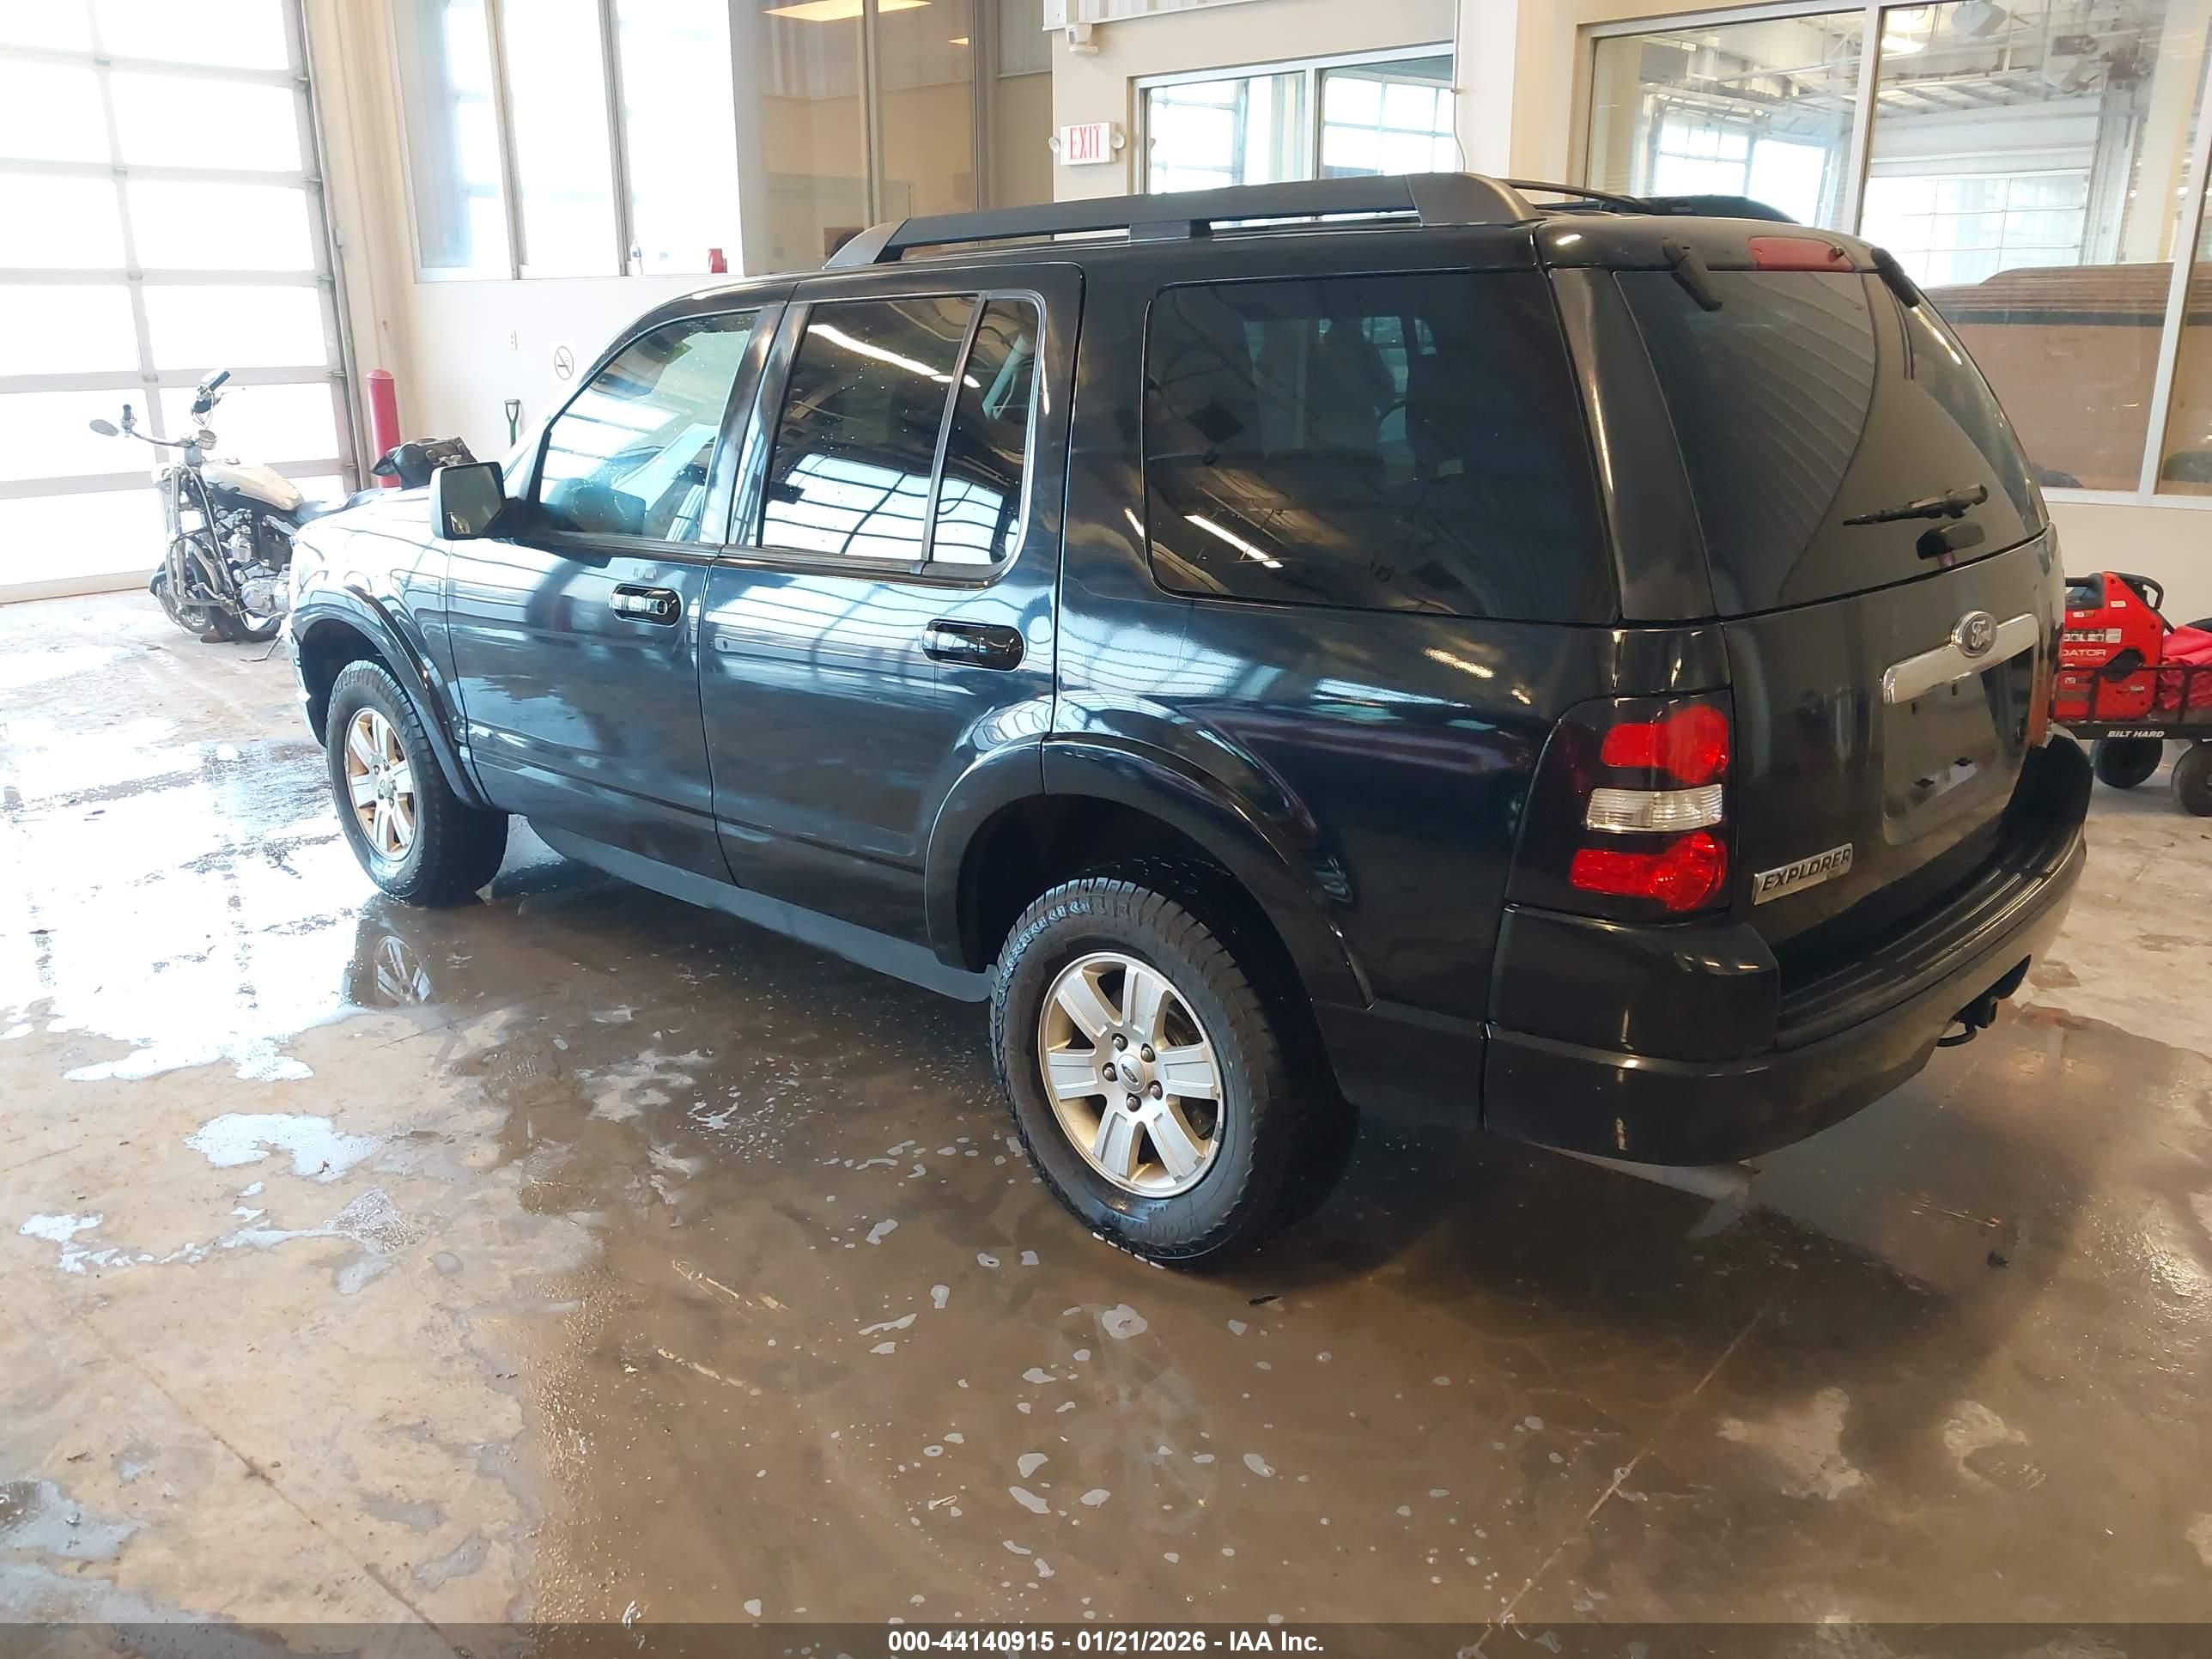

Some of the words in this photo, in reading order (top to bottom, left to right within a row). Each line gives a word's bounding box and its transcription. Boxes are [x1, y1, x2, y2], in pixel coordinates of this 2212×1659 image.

[1070, 125, 1102, 160] EXIT
[2107, 730, 2133, 738] BILT
[2134, 730, 2165, 738] HARD
[1761, 848, 1851, 891] EXPLORER
